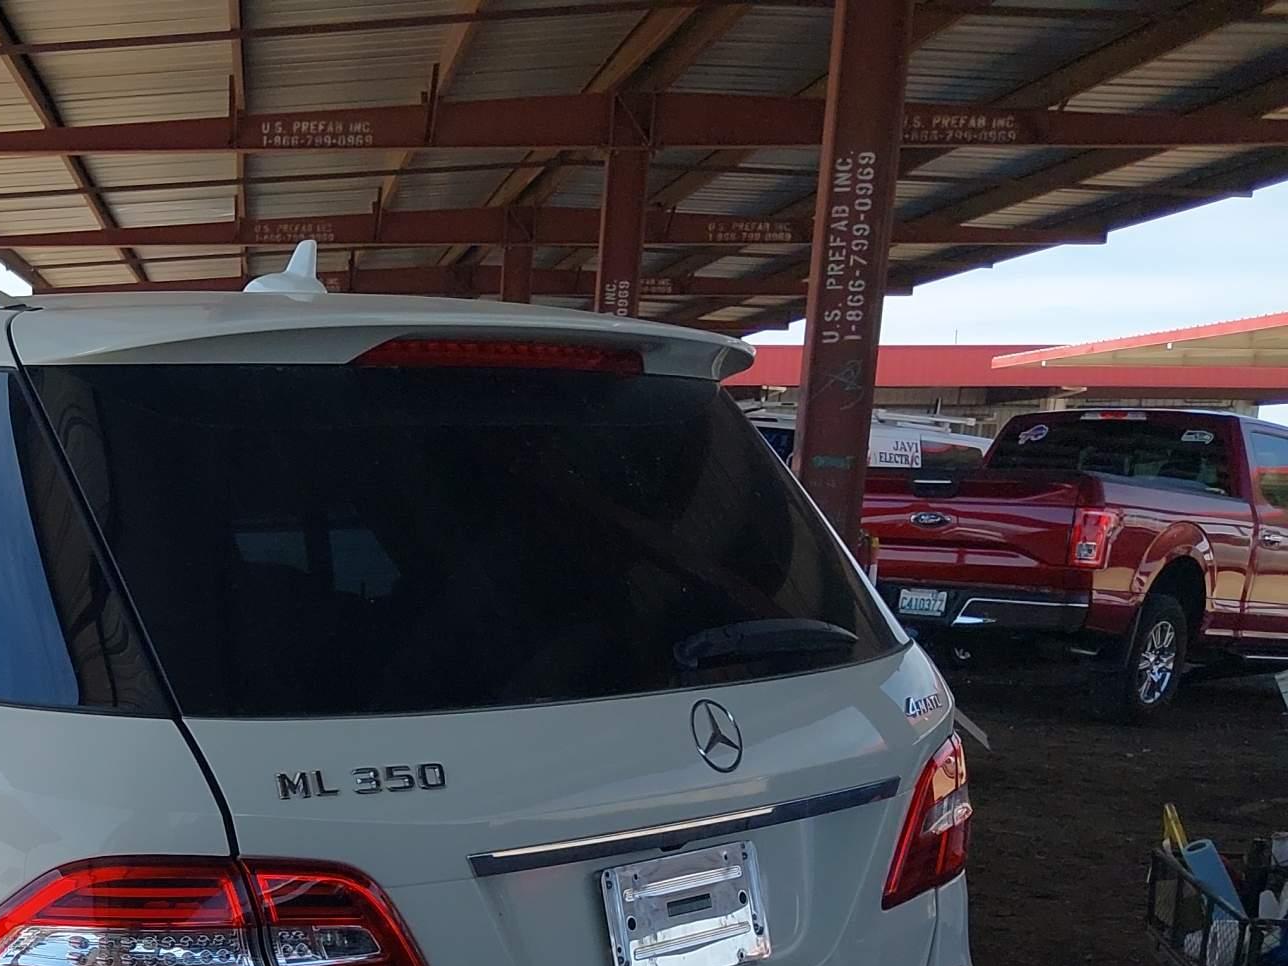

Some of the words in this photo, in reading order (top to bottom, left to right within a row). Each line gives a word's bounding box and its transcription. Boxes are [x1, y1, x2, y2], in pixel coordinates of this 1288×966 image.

[292, 120, 343, 134] PREFAB
[932, 115, 987, 129] PREFAB
[833, 151, 854, 192] INC.
[826, 205, 849, 289] PREFAB
[844, 151, 876, 340] 1-866-799-0969
[822, 303, 842, 343] U.S.
[879, 451, 920, 466] ELECTRIC
[893, 440, 919, 453] JAVI
[276, 769, 340, 800] ML
[351, 762, 447, 795] 350
